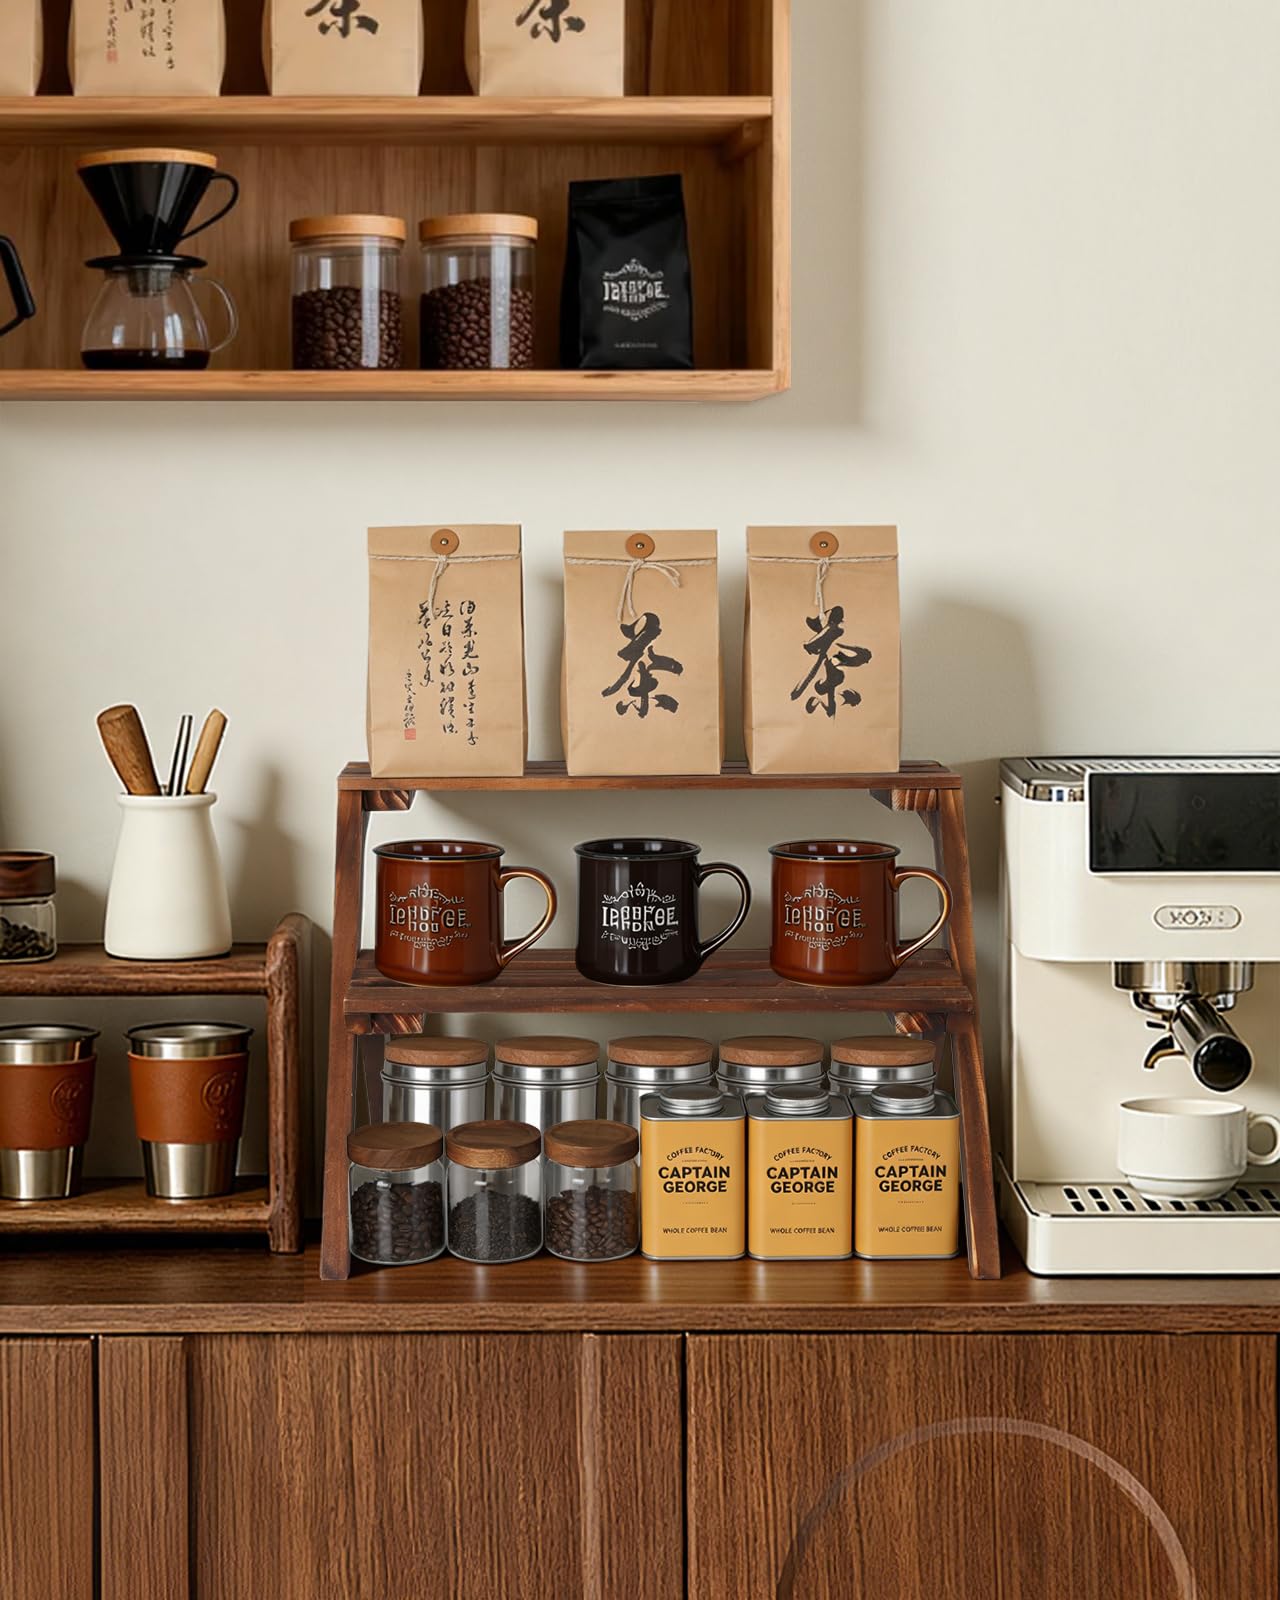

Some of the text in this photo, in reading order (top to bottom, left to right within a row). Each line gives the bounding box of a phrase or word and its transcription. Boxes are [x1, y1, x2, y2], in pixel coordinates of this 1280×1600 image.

[601, 612, 683, 718] 茶
[790, 606, 872, 719] 茶
[667, 1147, 693, 1161] COFFEE
[774, 1147, 800, 1161] COFFEE
[882, 1145, 941, 1160] COFFEE FACTORY
[658, 1166, 730, 1179] CAPTAIN
[766, 1166, 838, 1179] CAPTAIN
[875, 1165, 946, 1178] CAPTAIN
[663, 1180, 727, 1193] GEORGE
[770, 1181, 834, 1193] GEORGE
[879, 1179, 942, 1192] GEORGE
